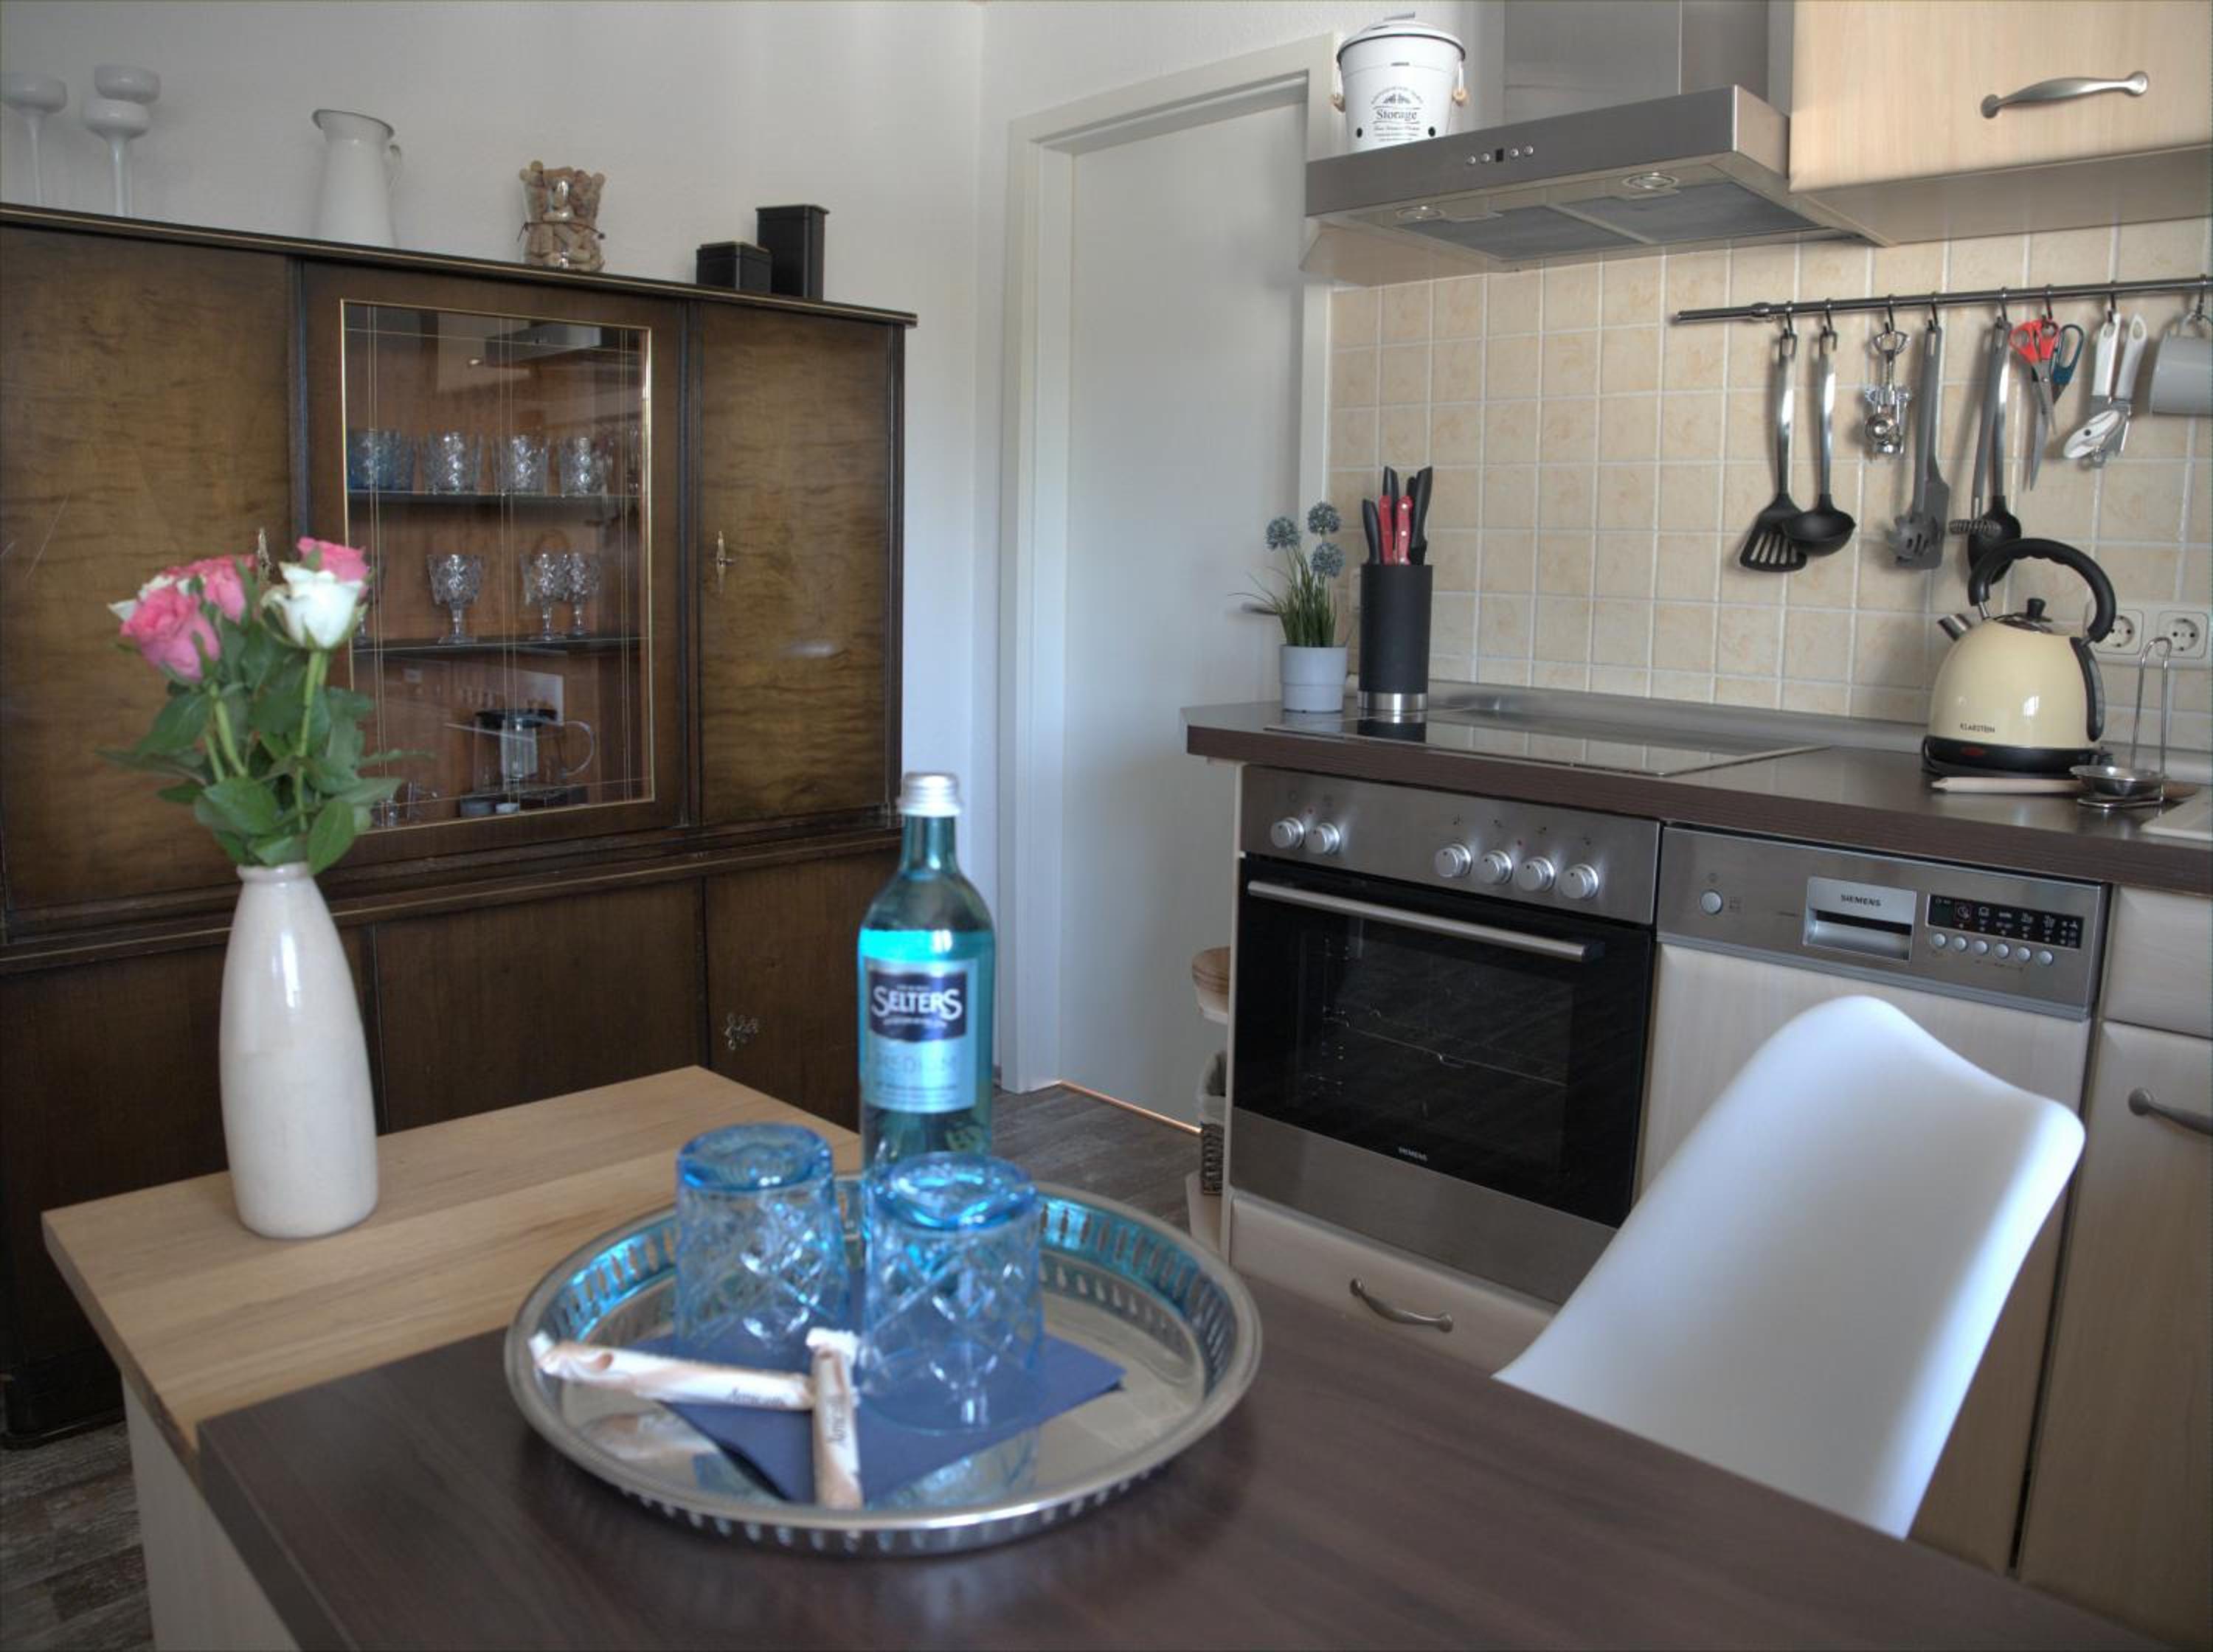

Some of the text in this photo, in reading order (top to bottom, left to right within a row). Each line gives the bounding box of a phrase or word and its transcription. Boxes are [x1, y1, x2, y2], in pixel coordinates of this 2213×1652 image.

[1376, 109, 1417, 121] Storage
[1840, 894, 1881, 906] SIEMENS
[871, 985, 963, 1021] SELTERS
